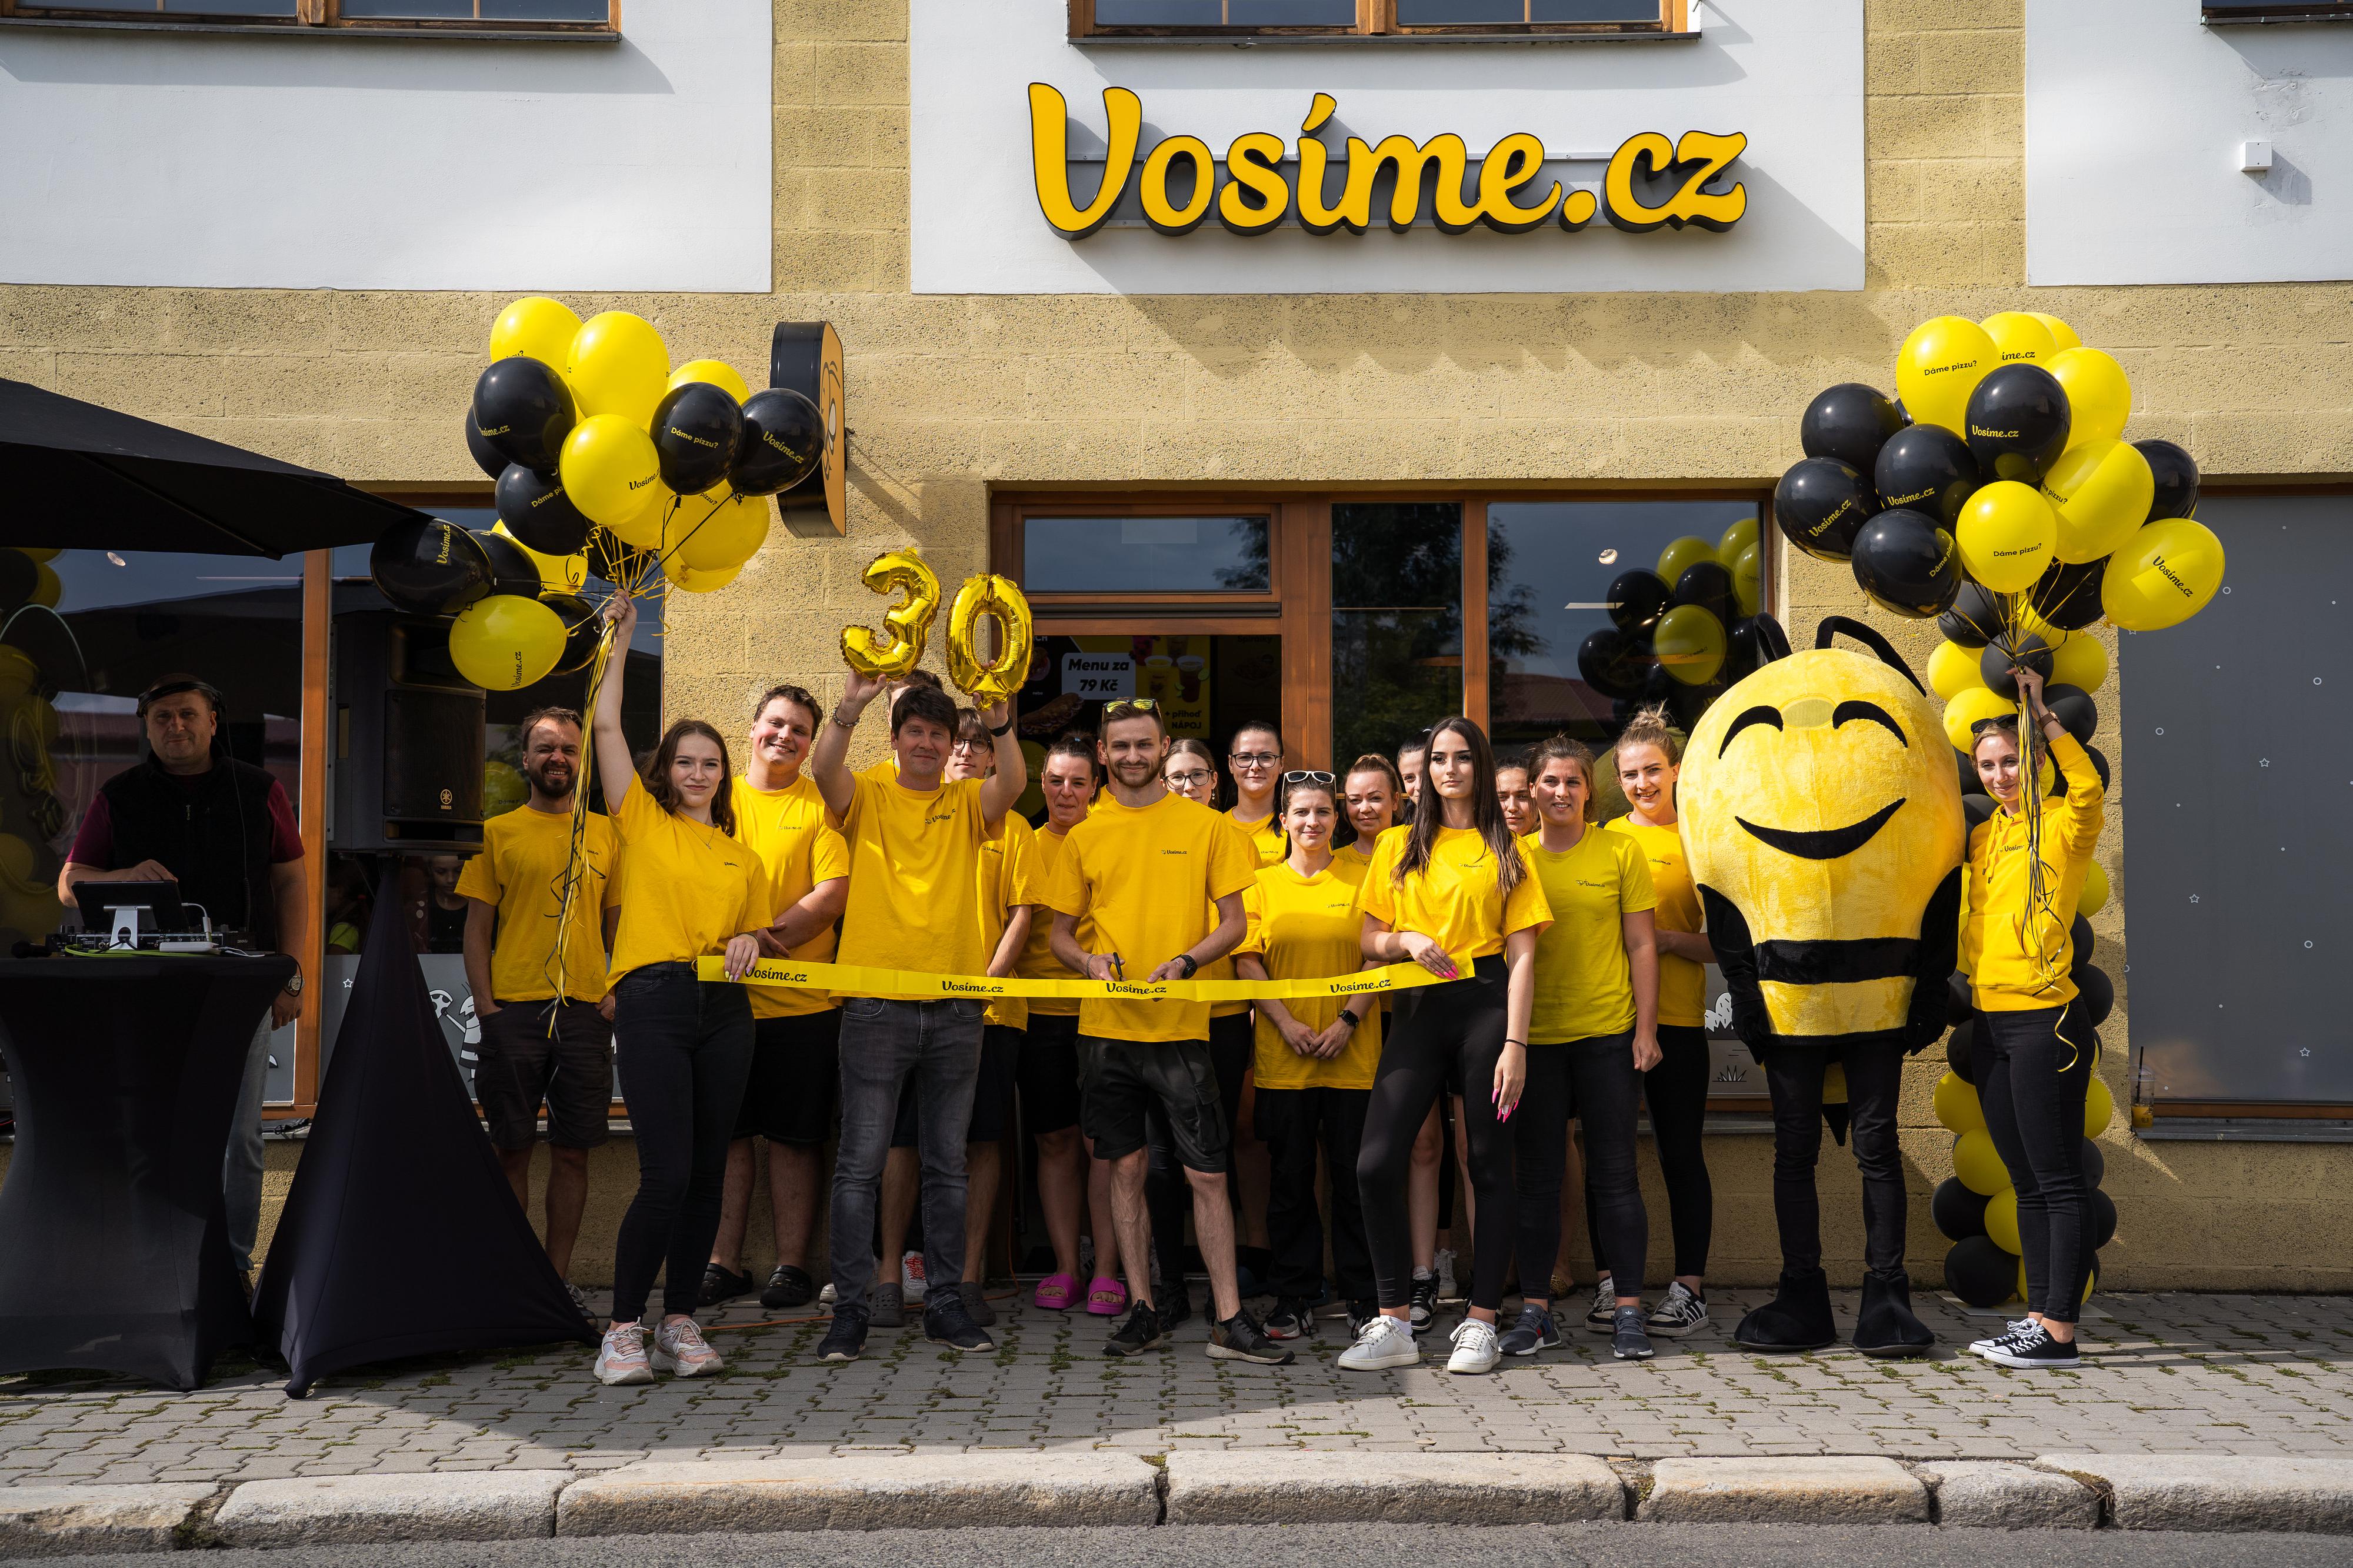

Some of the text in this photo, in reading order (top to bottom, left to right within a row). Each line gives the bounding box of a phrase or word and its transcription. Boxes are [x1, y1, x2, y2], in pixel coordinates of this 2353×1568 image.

[1028, 82, 1747, 239] Vosíme.cz
[2001, 351, 2035, 361] íme.cz
[1924, 360, 1977, 376] Dáme pizzu?
[671, 427, 719, 449] Dáme pizzu?
[1972, 424, 2019, 438] Vosíme.cz
[763, 431, 805, 463] Vosíme.cz
[531, 485, 564, 508] Dáme piz
[699, 492, 718, 506] pizzu?
[1887, 488, 1935, 506] Vosíme.cz
[2048, 489, 2068, 504] pizzu?
[1808, 499, 1852, 537] Vosíme.cz
[436, 523, 451, 564] Vosíme.cz
[2019, 543, 2042, 555] pizzu?
[1929, 556, 1948, 577] Dáme
[2153, 555, 2194, 598] Vosíme.cz
[511, 651, 522, 688] Vosíme.cz
[1068, 658, 1129, 671] Menu za
[1079, 679, 1118, 692] 79 Kč
[1172, 710, 1202, 719] přihoď
[1171, 720, 1202, 730] NÁPOJ
[942, 980, 1004, 993] Vosíme.cz
[1106, 981, 1167, 995] Vosíme.cz
[1330, 979, 1391, 994] Vosíme.cz
